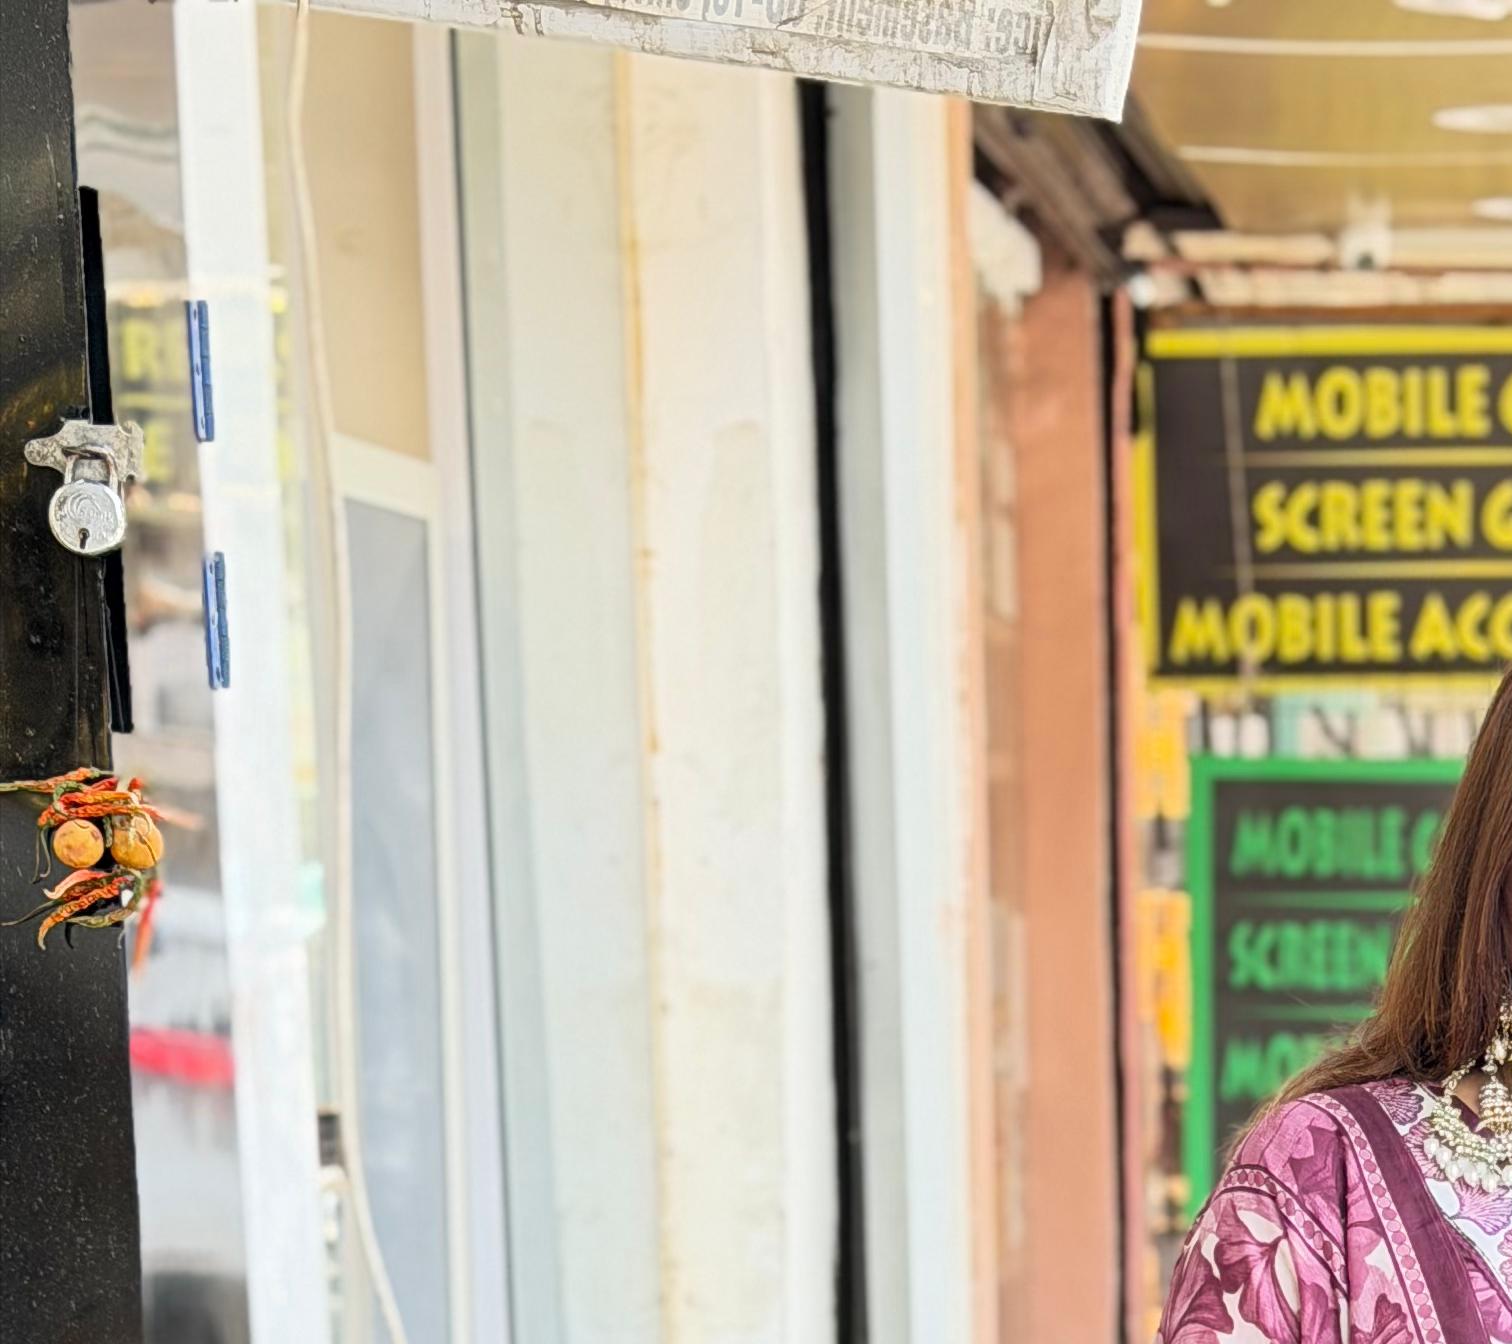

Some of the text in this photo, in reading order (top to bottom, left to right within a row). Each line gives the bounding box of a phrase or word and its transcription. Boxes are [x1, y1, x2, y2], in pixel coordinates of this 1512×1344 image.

[1253, 364, 1492, 441] MOBILE
[1252, 478, 1475, 553] SCREEN
[1168, 591, 1400, 665] MOBILE
[1230, 805, 1404, 880] MOBILE
